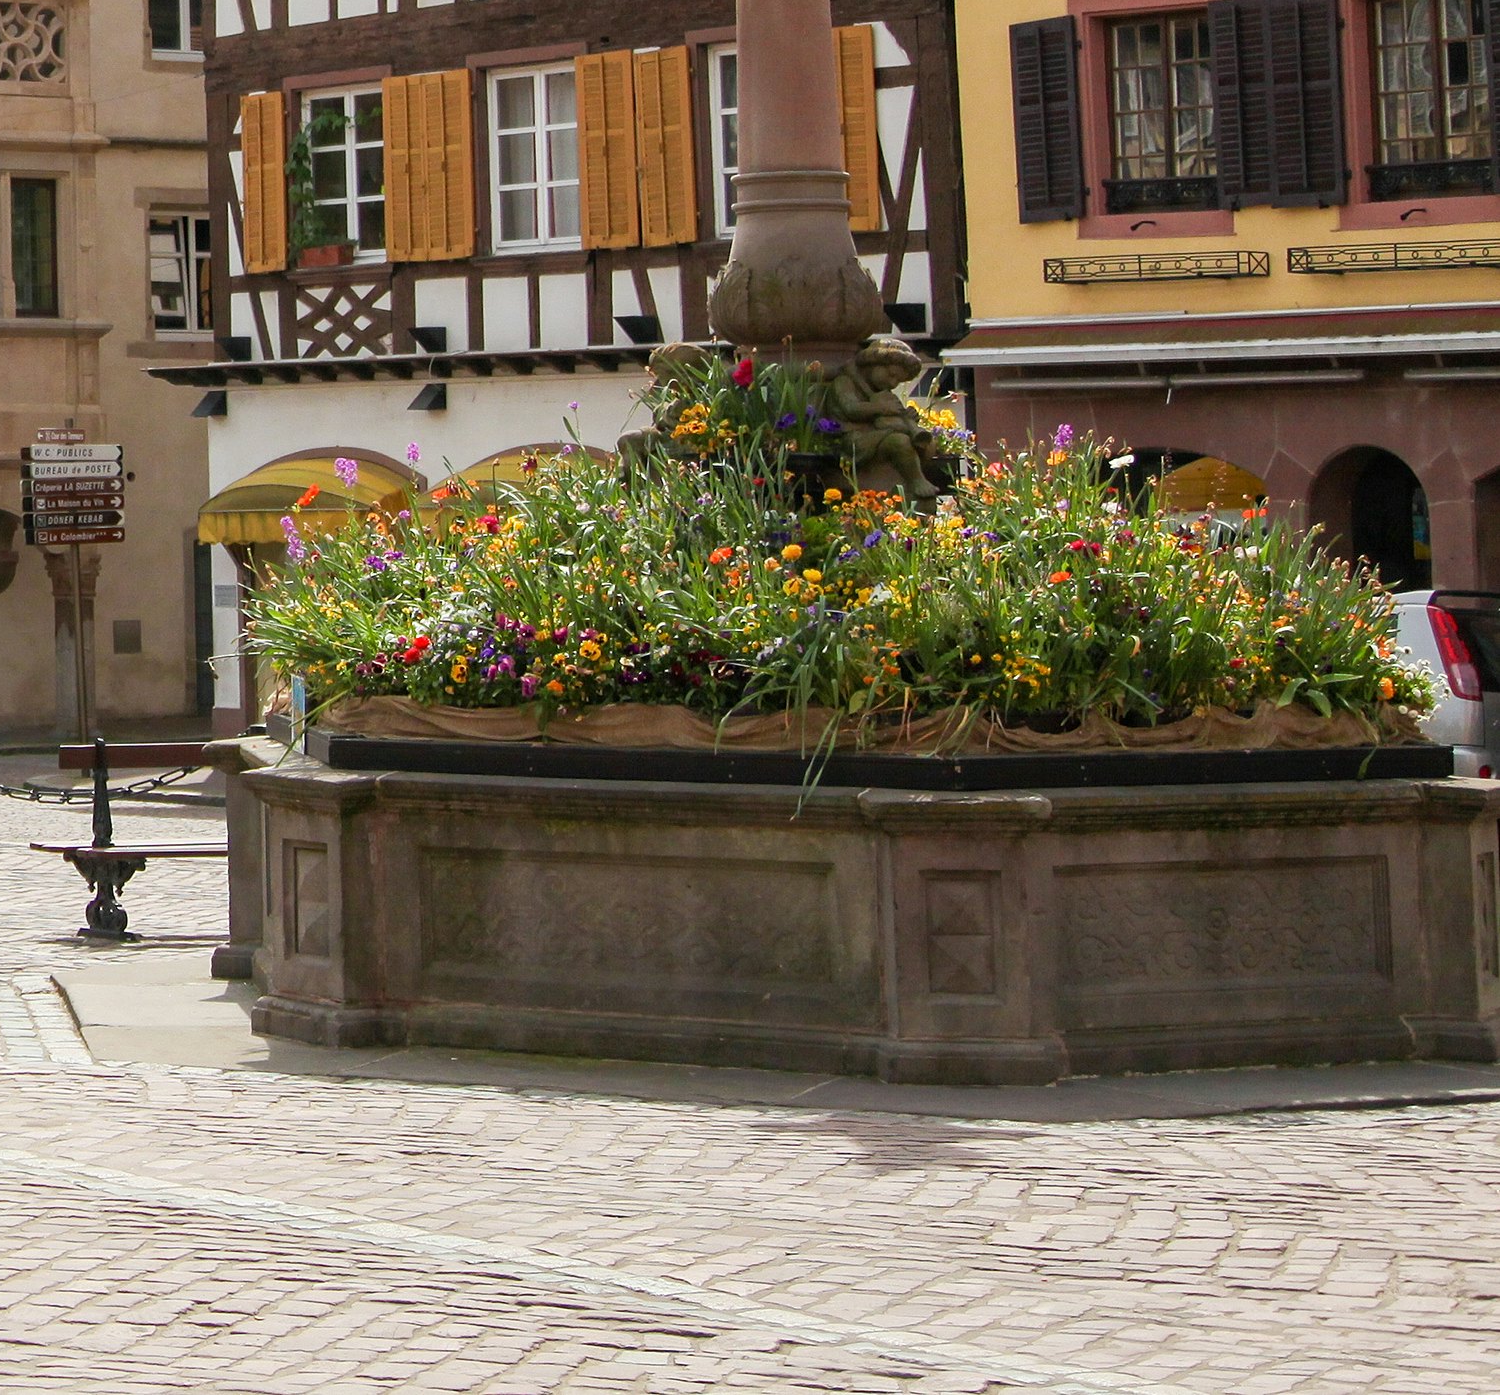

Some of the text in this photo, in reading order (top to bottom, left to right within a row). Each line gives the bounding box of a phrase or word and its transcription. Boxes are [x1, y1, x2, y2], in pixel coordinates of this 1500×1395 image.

[56, 448, 93, 458] PUBLICS
[34, 464, 112, 476] BUREAU de POSTE
[64, 482, 74, 491] LA
[75, 481, 105, 490] SUZETTE
[47, 514, 104, 525] DÖNER KEBAB
